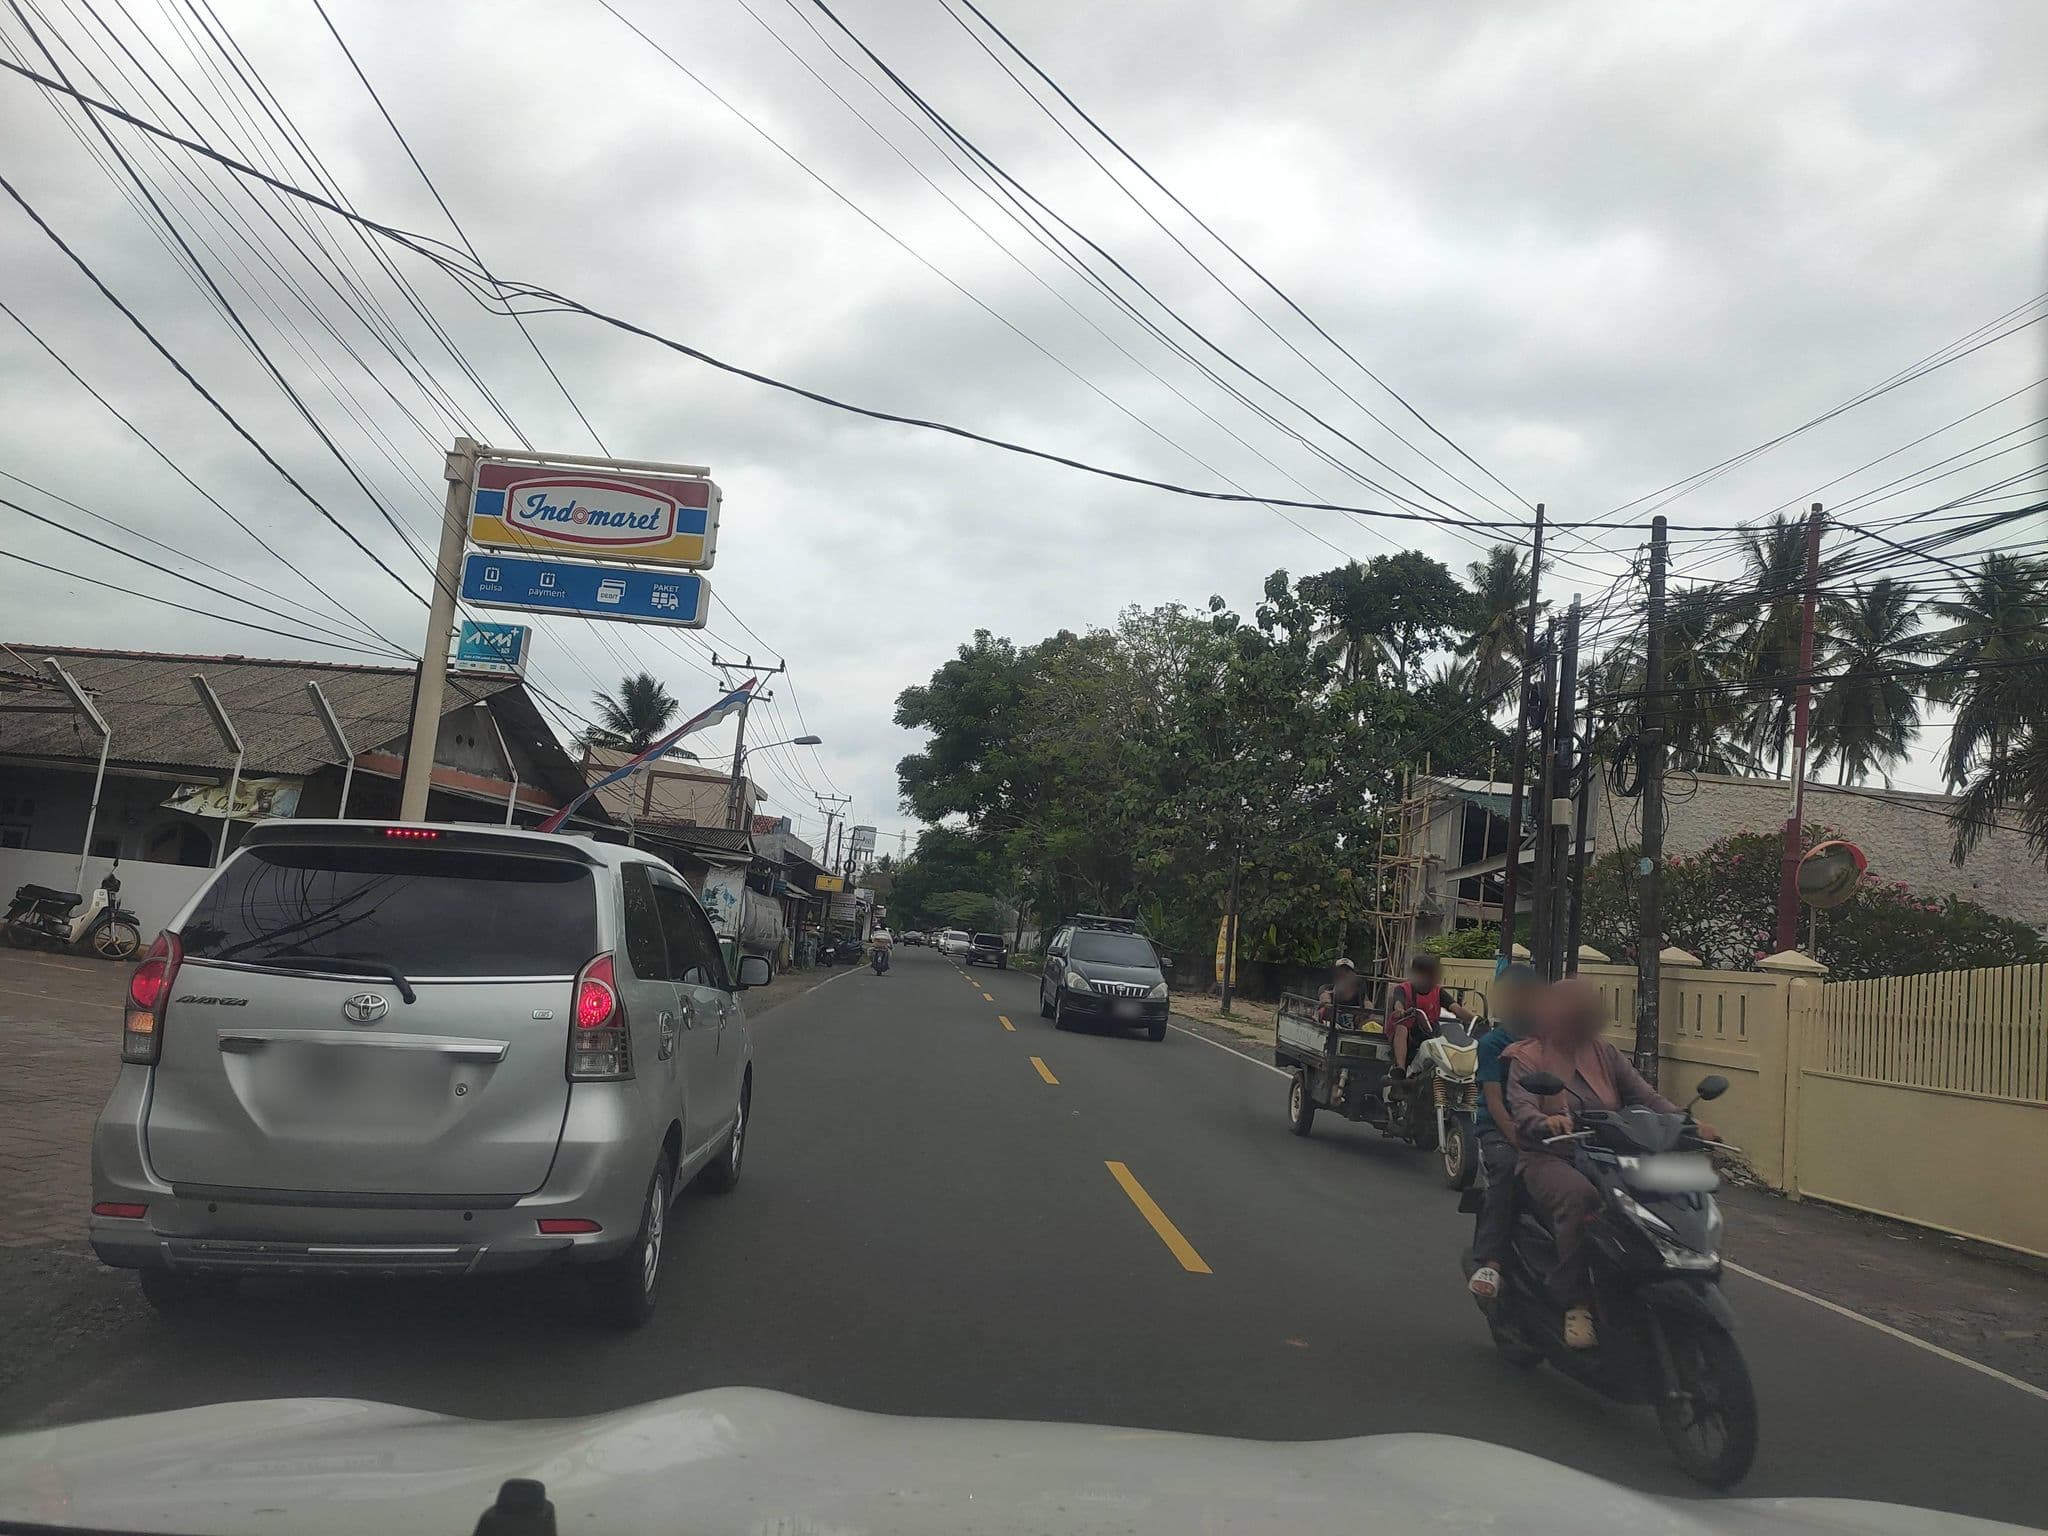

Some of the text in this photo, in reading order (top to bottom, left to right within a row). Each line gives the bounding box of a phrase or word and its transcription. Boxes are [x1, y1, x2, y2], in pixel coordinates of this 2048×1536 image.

[519, 493, 661, 531] Indomaret
[479, 583, 503, 592] pulsa
[528, 587, 566, 598] payment
[653, 583, 679, 593] PAKET
